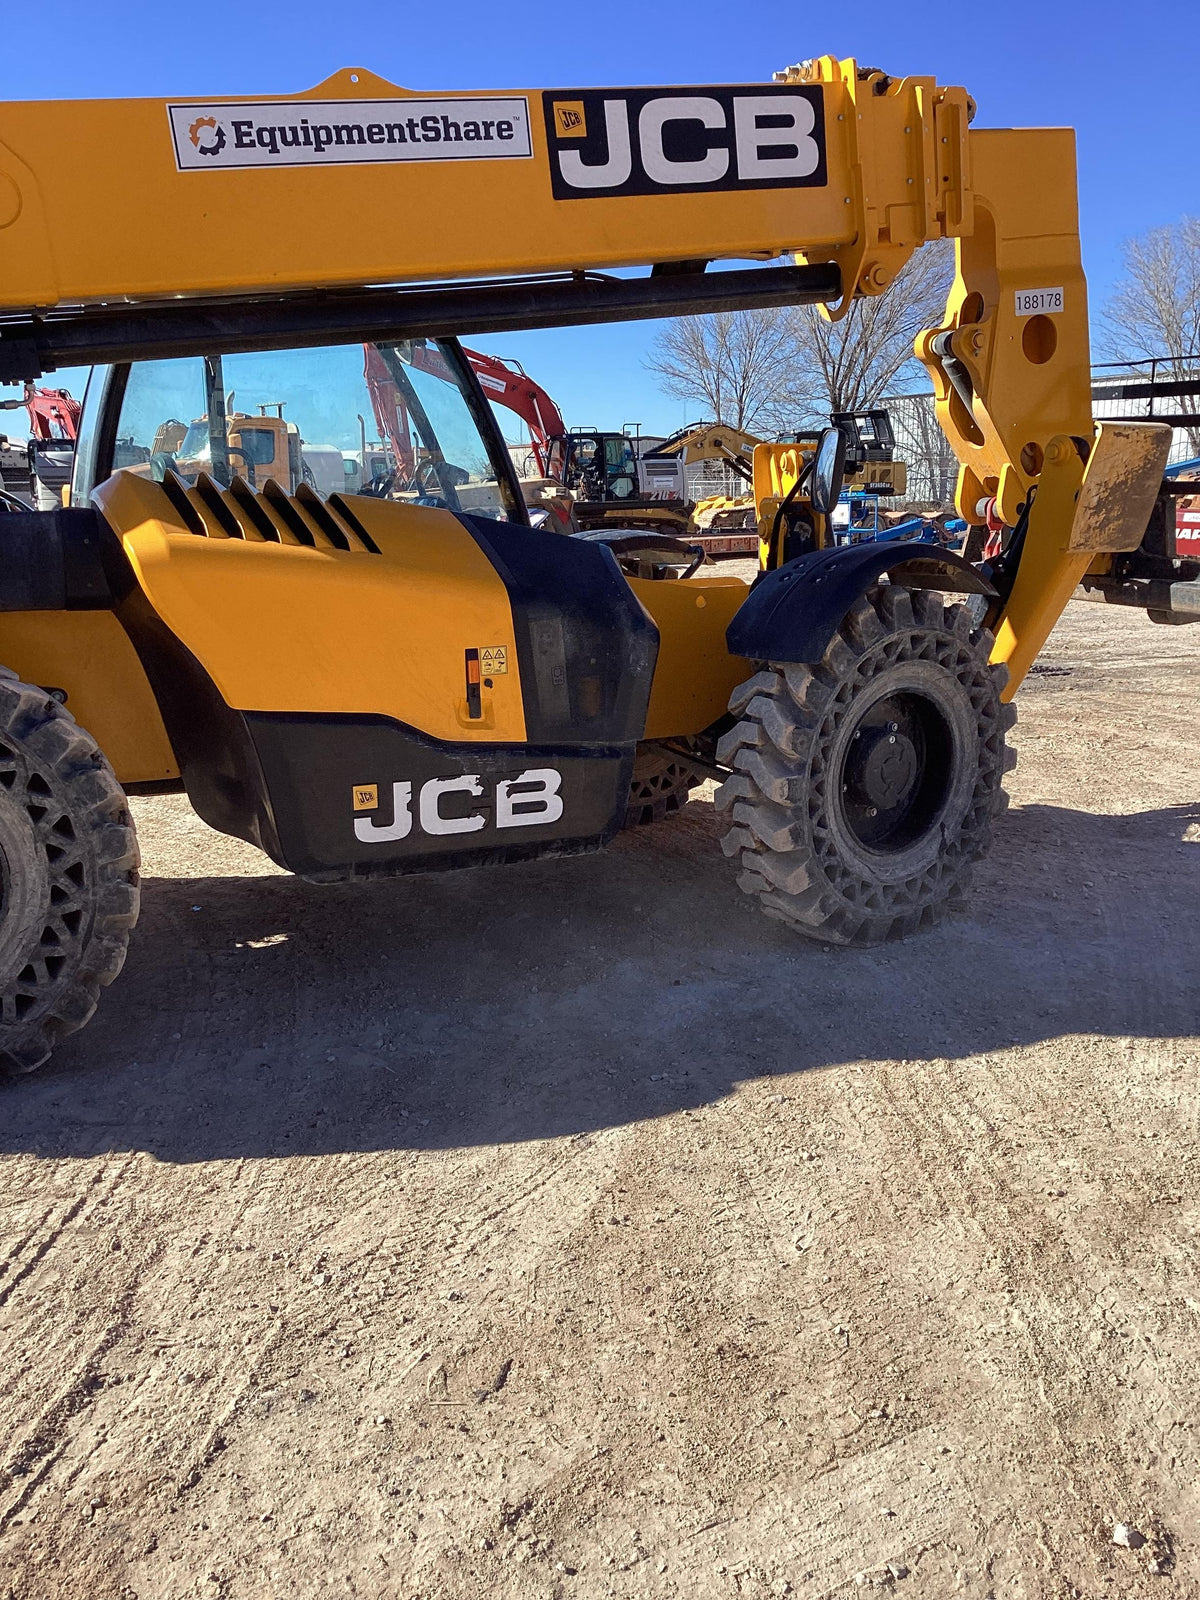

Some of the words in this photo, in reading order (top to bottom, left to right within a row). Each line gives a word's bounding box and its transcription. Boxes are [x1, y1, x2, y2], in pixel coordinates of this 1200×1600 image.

[561, 110, 582, 128] JCB
[231, 115, 515, 154] EquipmentShare
[558, 95, 819, 189] JCB
[1016, 292, 1062, 310] 188178
[353, 768, 563, 843] JCB
[359, 792, 374, 804] JCB
